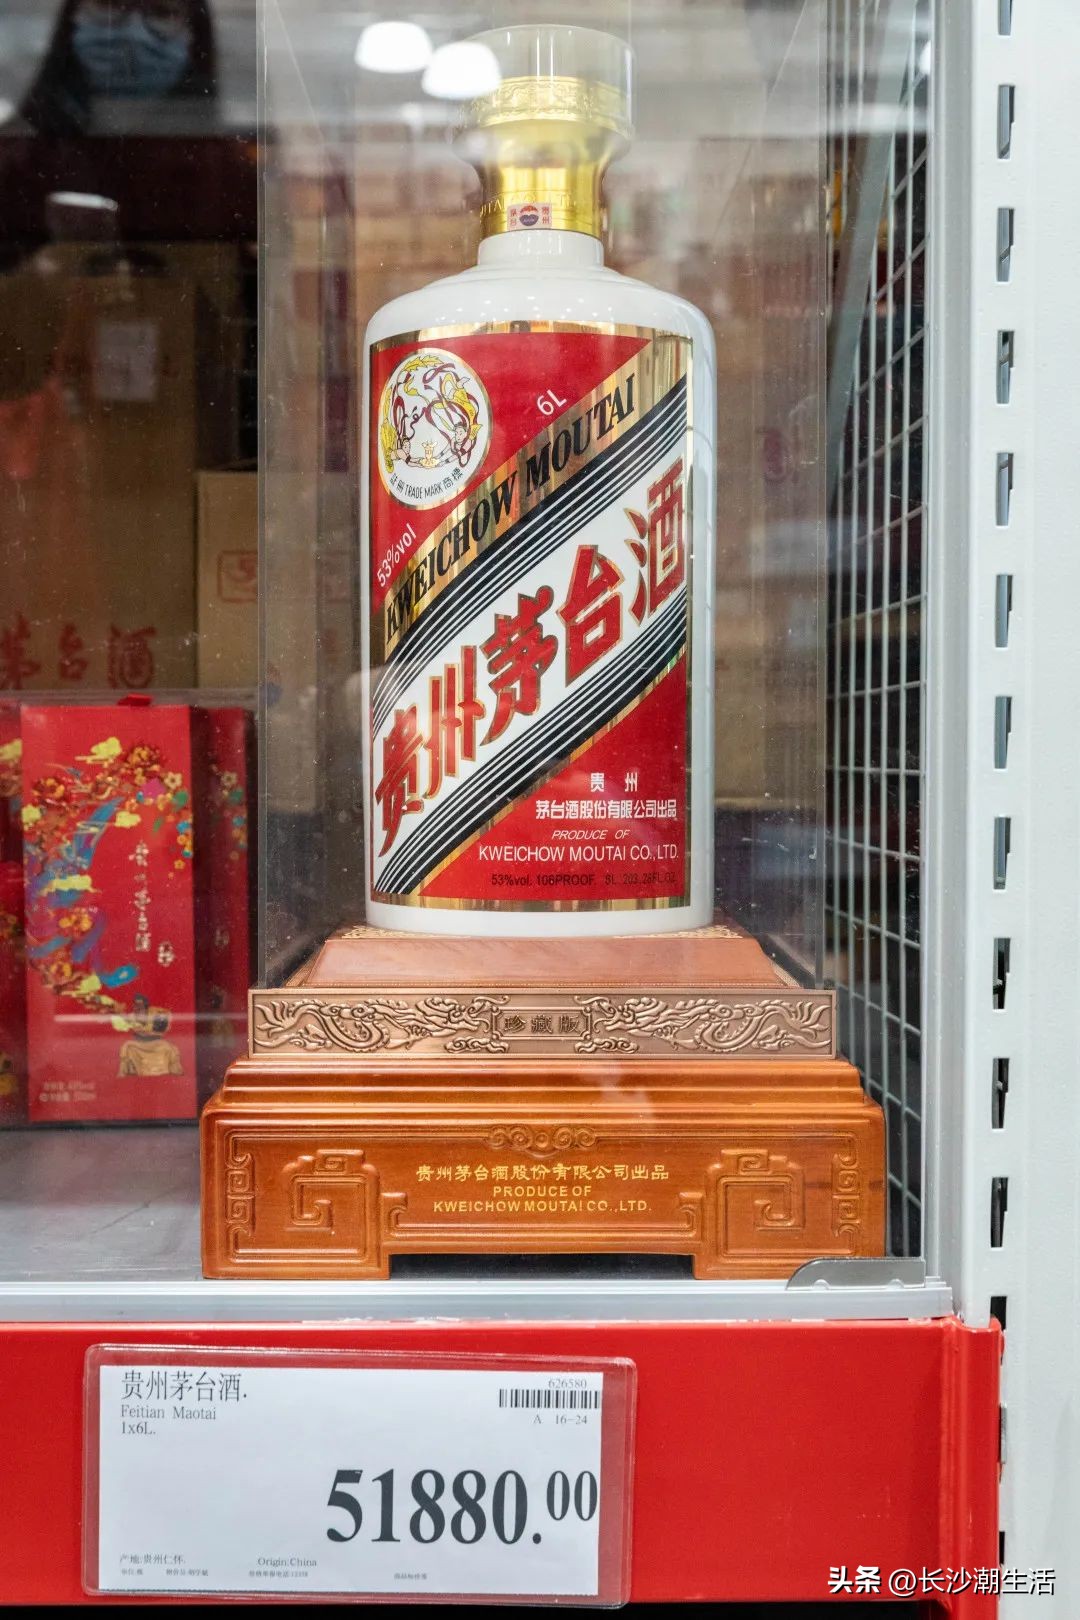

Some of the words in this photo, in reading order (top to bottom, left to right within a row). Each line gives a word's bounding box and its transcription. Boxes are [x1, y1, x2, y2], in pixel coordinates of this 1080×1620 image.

[536, 389, 567, 416] 6L
[404, 484, 423, 499] TRADE
[424, 480, 444, 499] MARK
[386, 470, 518, 645] KWEICHOW
[524, 373, 637, 496] MOUTAI
[376, 524, 417, 587] 53%vol
[375, 456, 685, 858] 贵州茅台酒
[535, 800, 677, 820] 茅台酒股份有限公司出品
[551, 829, 608, 840] PRODUCE
[614, 829, 631, 840] OF
[479, 845, 565, 862] KWEICHOW
[569, 845, 626, 862] MOUTAI
[503, 1014, 581, 1034] 珍藏版
[415, 1162, 670, 1182] 贵州茅台酒股份有限公司出品
[493, 1186, 569, 1198] PRODUCE
[572, 1186, 593, 1198] OF
[433, 1201, 522, 1213] KWEICHOW
[524, 1200, 583, 1213] MOUTAI
[548, 1379, 588, 1390] 626580
[120, 1404, 165, 1419] Feitian
[172, 1405, 217, 1420] Maotai
[533, 1414, 542, 1425] A
[555, 1414, 588, 1425] 16-24
[326, 1468, 599, 1545] 51880.00
[257, 1556, 318, 1568] Origin:China
